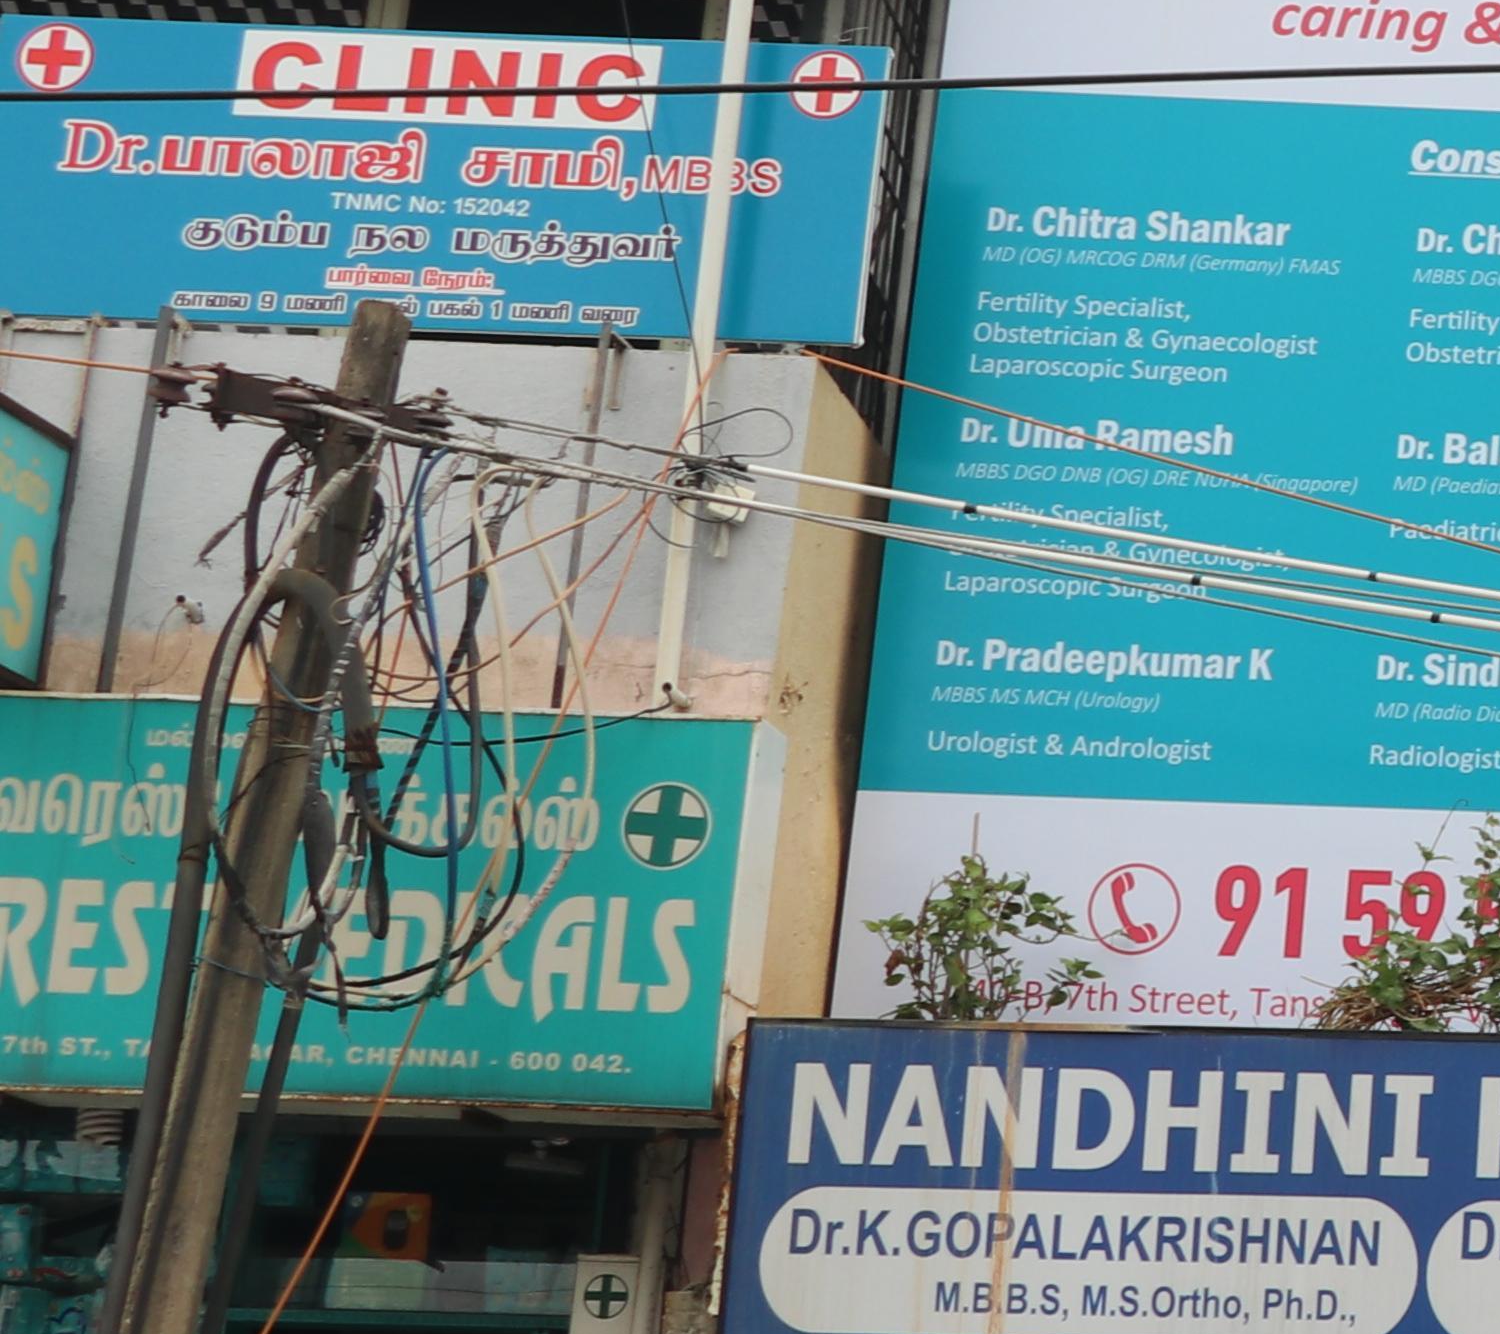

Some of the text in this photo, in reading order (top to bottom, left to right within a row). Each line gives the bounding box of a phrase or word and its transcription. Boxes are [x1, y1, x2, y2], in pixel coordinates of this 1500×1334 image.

[250, 40, 647, 123] CLINIC
[331, 192, 531, 217] TNMC No: 152042
[182, 210, 681, 267] குடும்ப நல மருத்துவர்
[986, 205, 1292, 247] Dr. Chitra Shankar
[1417, 227, 1454, 253] Dr.
[982, 246, 1340, 276] MD (OG) MRCOG DRM (Germany) FMAS
[977, 291, 1191, 323] Fertility Specialist,
[973, 321, 1318, 359] Obstetrician & Gynaecologist
[969, 353, 1228, 386] Laparoscopic Surgeon
[936, 638, 1273, 682] Dr. Pradeepkumar K
[927, 730, 1212, 764] Urologist & Andrologist
[345, 1045, 631, 1074] CHENNAI 600 042.
[787, 1062, 1434, 1177] NANDHINI
[788, 1208, 1381, 1266] Dr.K.GOPALAKRISHNAN
[934, 1281, 1069, 1321] M.B.B.S,
[1081, 1285, 1250, 1324] M.S.Ortho,
